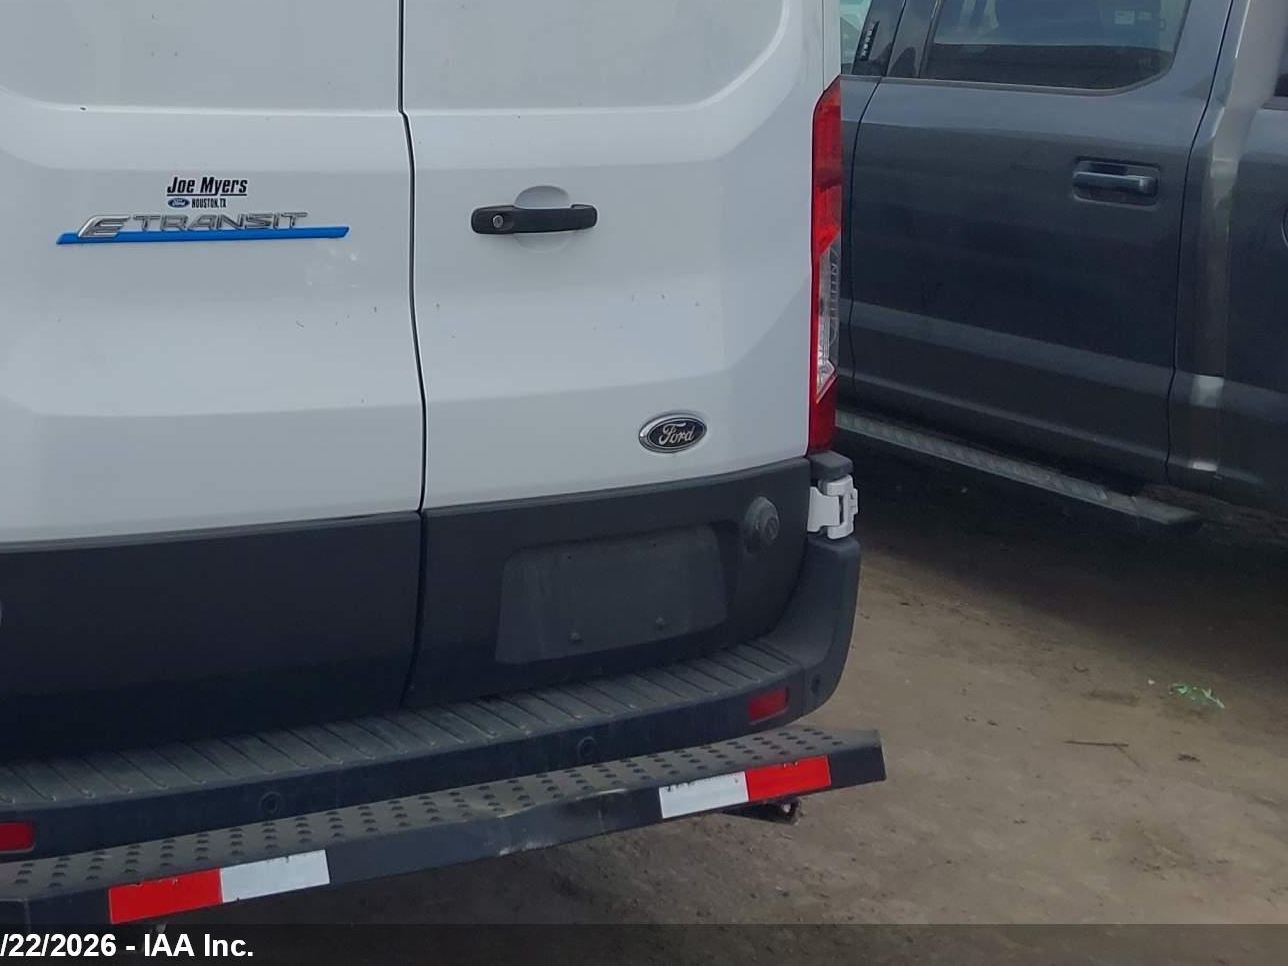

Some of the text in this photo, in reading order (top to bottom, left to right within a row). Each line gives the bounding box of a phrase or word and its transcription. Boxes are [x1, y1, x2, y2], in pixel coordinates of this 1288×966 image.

[167, 176, 248, 196] Joe Myers
[658, 422, 696, 445] Ford
